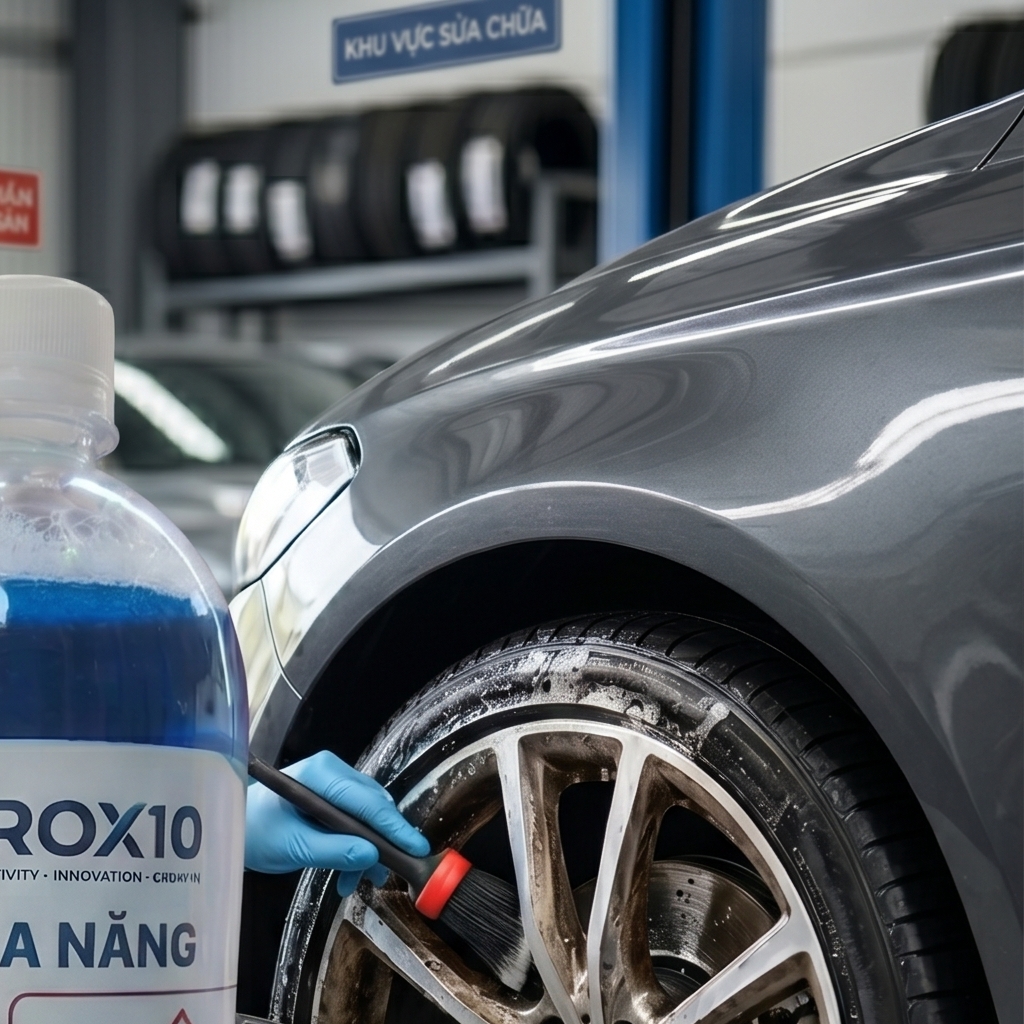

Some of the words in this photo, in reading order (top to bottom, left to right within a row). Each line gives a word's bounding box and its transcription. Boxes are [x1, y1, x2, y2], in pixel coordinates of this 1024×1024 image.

[344, 32, 387, 61] KHU
[53, 870, 142, 884] INNOVATION
[58, 910, 197, 968] NĂNG
